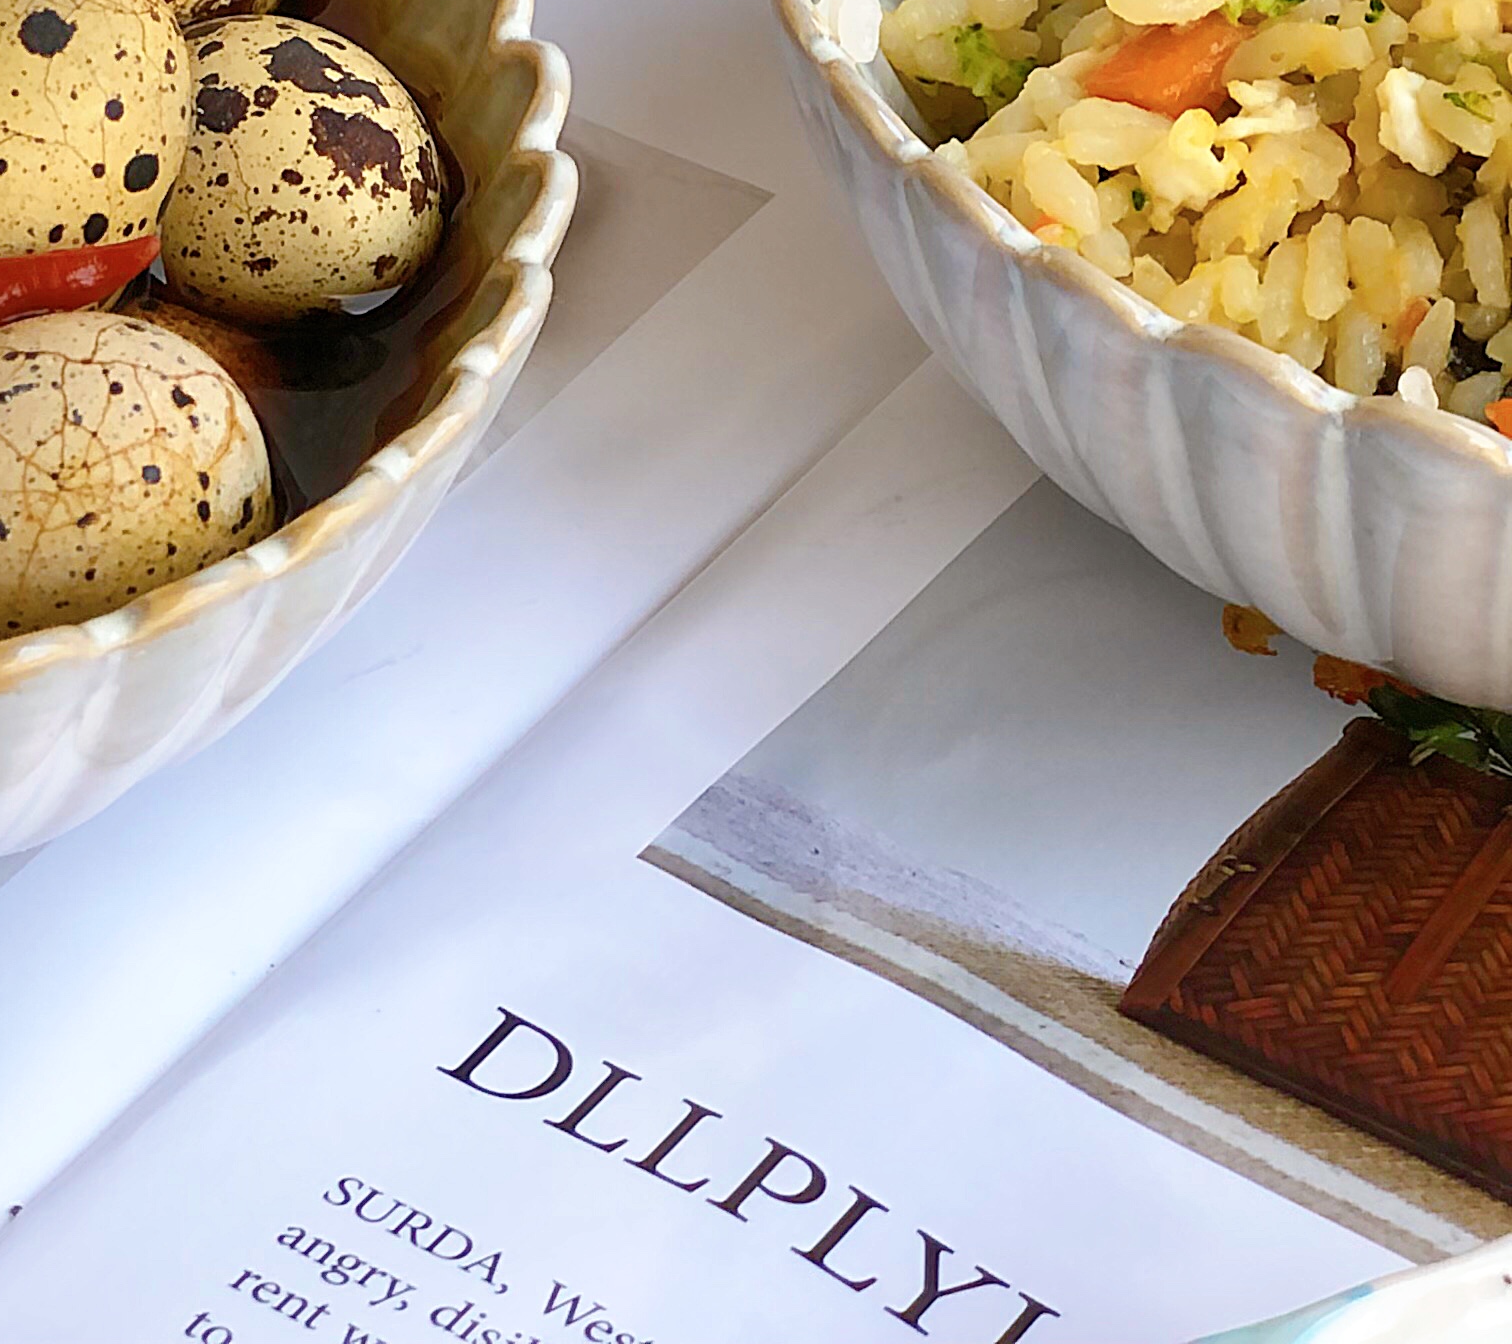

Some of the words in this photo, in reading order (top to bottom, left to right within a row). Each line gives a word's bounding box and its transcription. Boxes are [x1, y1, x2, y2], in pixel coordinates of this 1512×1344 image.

[228, 1269, 331, 1330] rent
[277, 1225, 417, 1311] angry,
[323, 1177, 509, 1295] SURDA,
[543, 1279, 654, 1344] Wes
